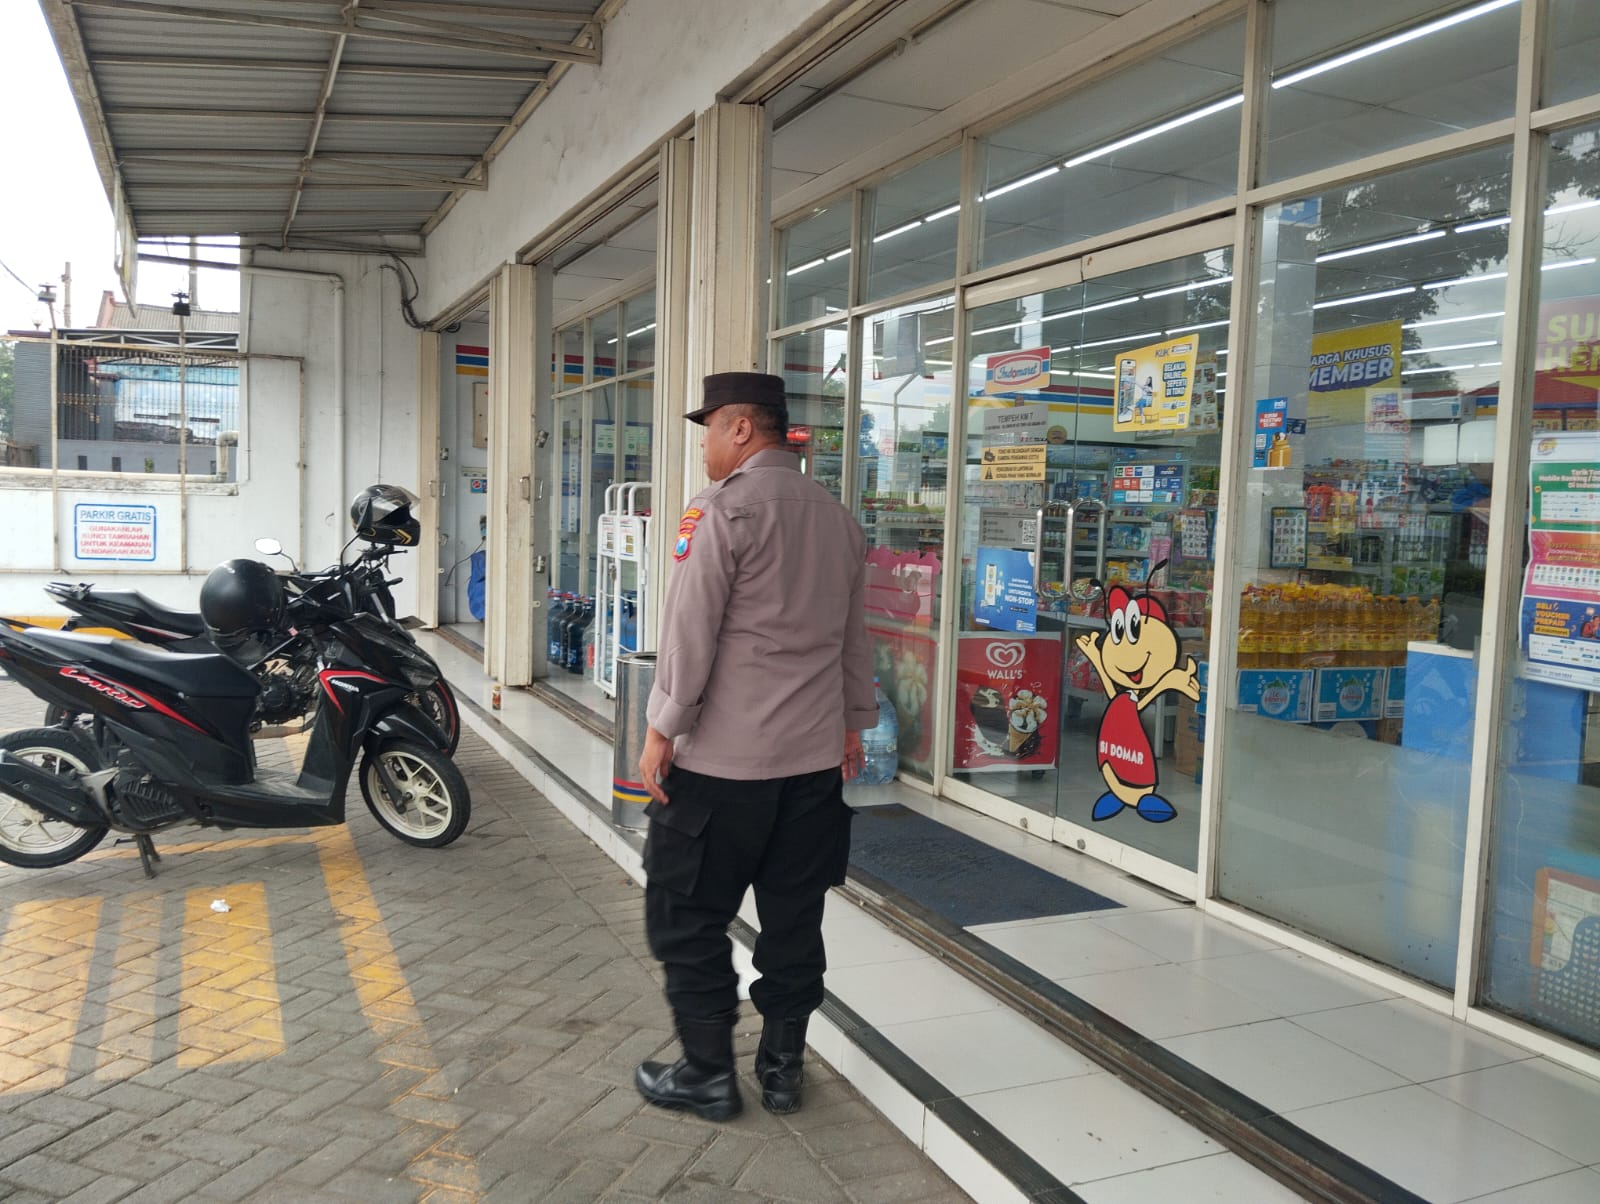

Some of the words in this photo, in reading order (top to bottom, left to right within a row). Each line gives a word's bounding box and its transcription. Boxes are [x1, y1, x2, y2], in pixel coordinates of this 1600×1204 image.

[1545, 311, 1600, 344] SU
[1311, 353, 1341, 366] ARGA
[1344, 344, 1392, 361] KHUSUS
[997, 362, 1038, 379] Indomaret
[80, 509, 115, 520] PARKIR
[117, 511, 152, 521] GRATIS
[987, 669, 1023, 680] WALL'S
[1110, 744, 1144, 765] DOMAR
